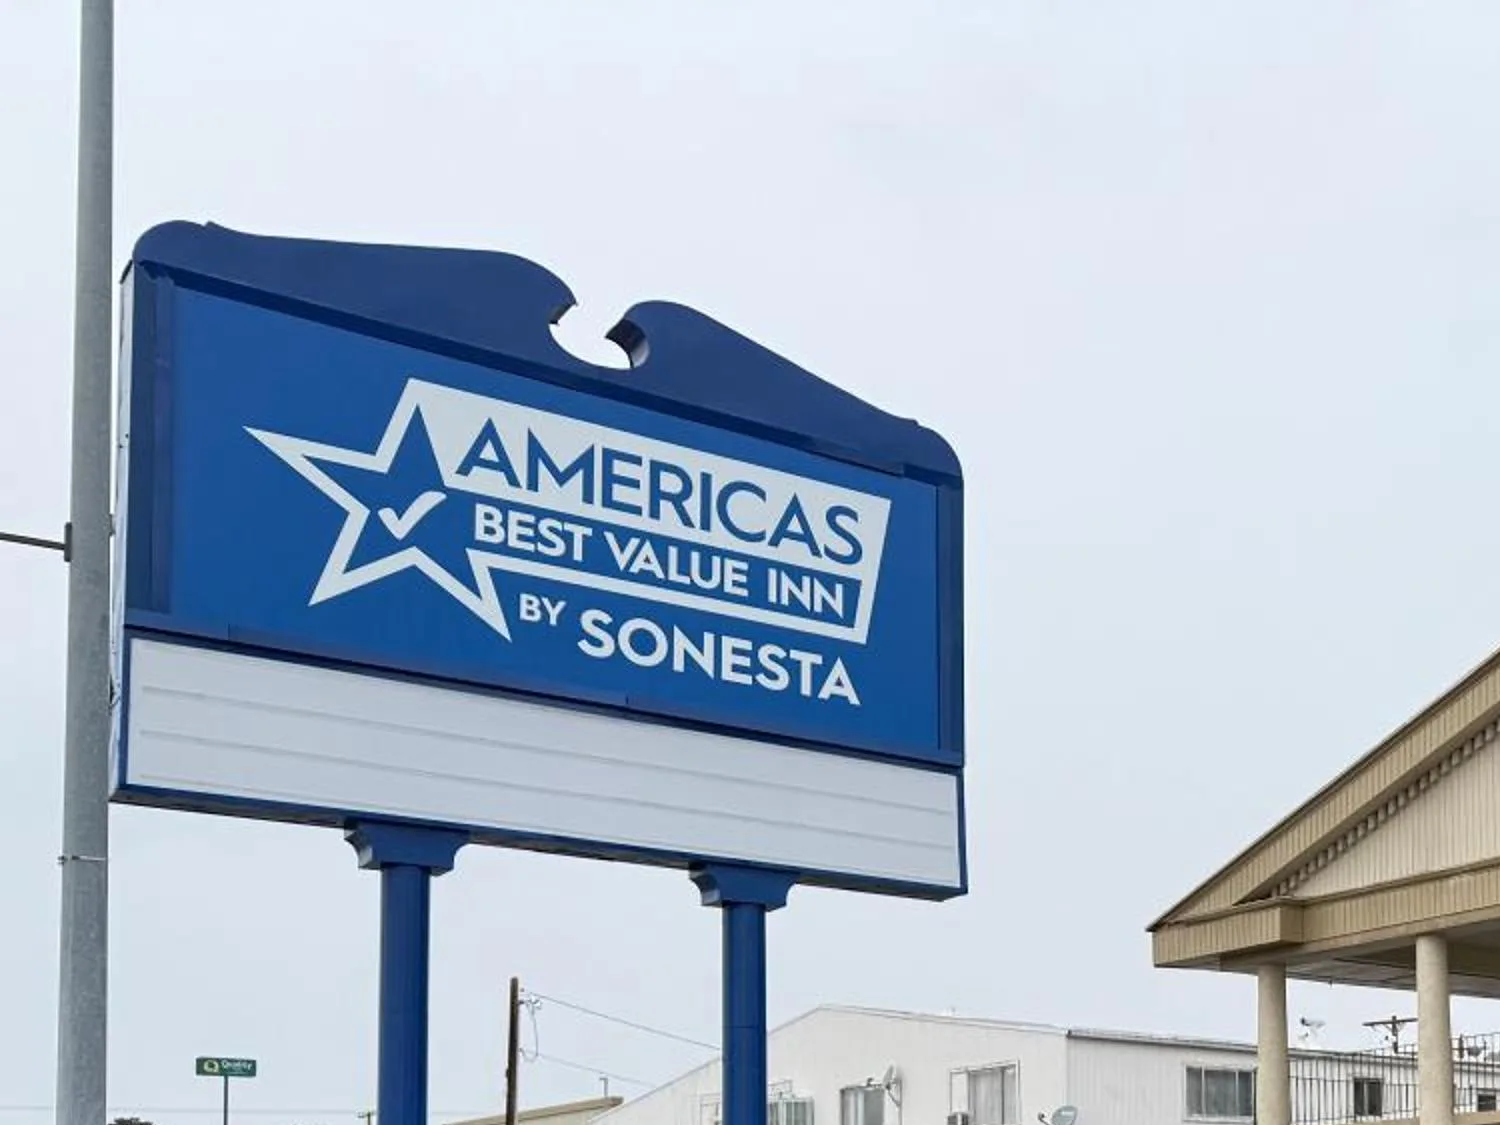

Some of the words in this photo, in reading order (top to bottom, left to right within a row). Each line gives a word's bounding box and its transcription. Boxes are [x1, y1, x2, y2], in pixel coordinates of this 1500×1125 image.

[455, 417, 863, 565] AMERICAS
[474, 503, 592, 562] BEST
[604, 532, 749, 598] VALUE
[767, 568, 843, 619] INN
[519, 593, 566, 626] BY
[577, 609, 861, 705] SONESTA
